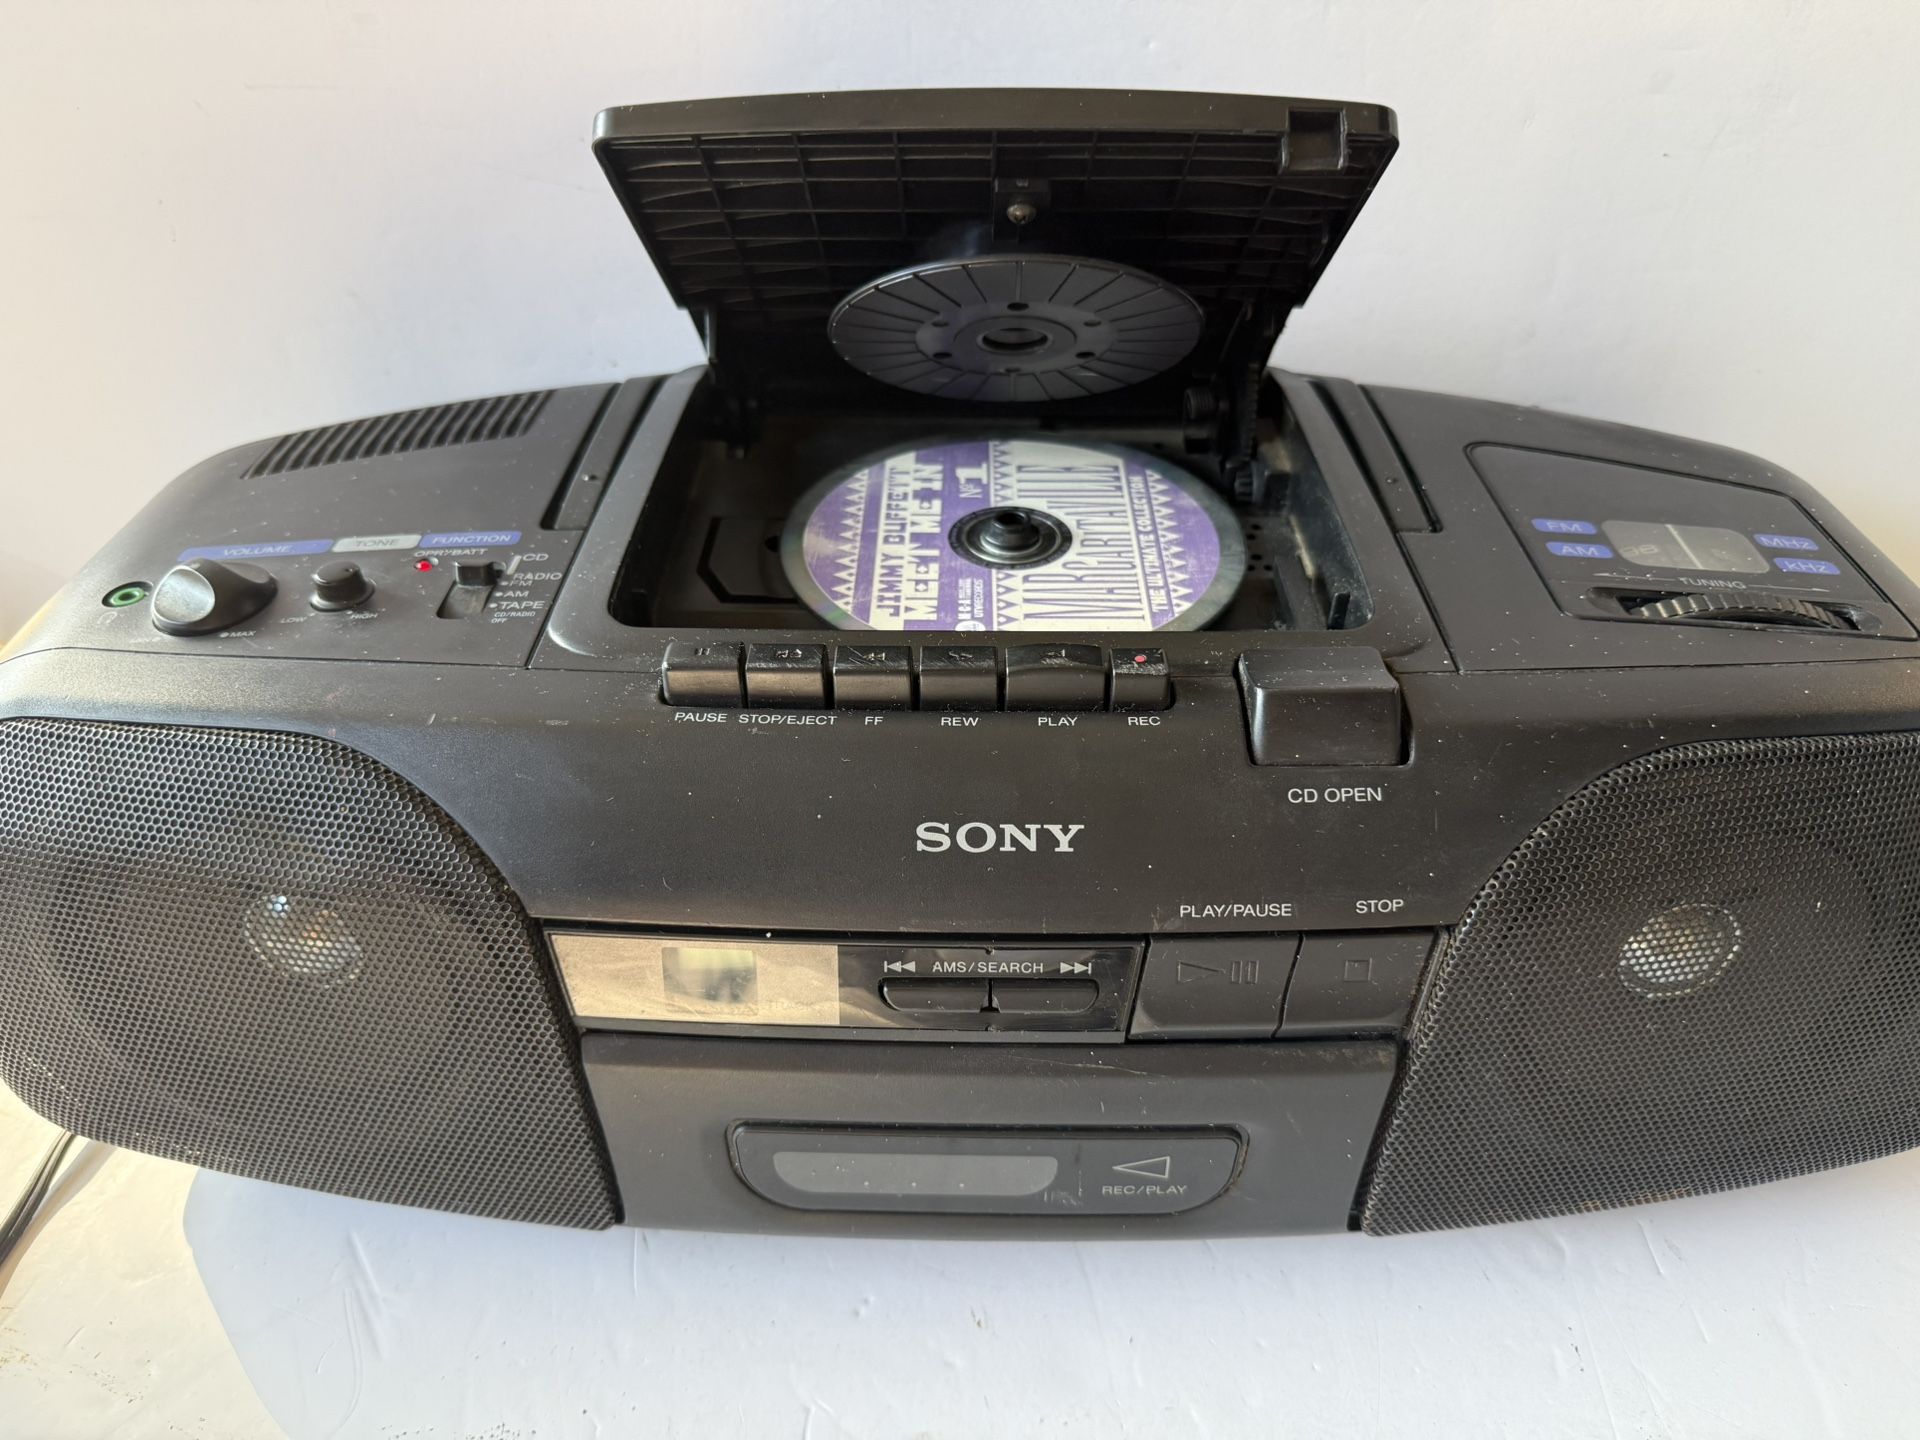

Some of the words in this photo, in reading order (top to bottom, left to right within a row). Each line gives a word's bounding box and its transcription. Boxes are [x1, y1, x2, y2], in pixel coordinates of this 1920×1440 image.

[912, 463, 944, 491] IN
[882, 467, 911, 546] BUFFETT
[1128, 475, 1153, 533] COLLECTION
[909, 499, 943, 534] ME
[1547, 522, 1582, 532] FM
[355, 538, 397, 548] TONE
[432, 535, 512, 544] FUNCTION
[1016, 464, 1146, 621] MARGARITAVILLE
[223, 544, 295, 557] VOLUME
[1562, 545, 1598, 556] AM
[522, 553, 550, 562] CD
[1138, 534, 1167, 587] ULTIMATE
[512, 572, 563, 581] RADIO
[903, 543, 941, 621] MEET
[876, 552, 905, 618] JIMMY
[1678, 577, 1746, 589] TUNING
[503, 590, 530, 598] AM
[1149, 587, 1171, 613] THE
[500, 601, 546, 609] TAPE
[350, 612, 379, 620] HIGH
[229, 630, 257, 638] MAX
[674, 711, 728, 723] PAUSE
[737, 713, 838, 726] STOP/EJECT
[864, 716, 884, 726] FF
[940, 716, 980, 727] REW
[1037, 716, 1079, 727] PLAY
[1127, 715, 1162, 726] REC
[1287, 788, 1318, 804] CD
[1323, 786, 1383, 803] OPEN
[915, 821, 1086, 854] SONY
[1179, 903, 1293, 919] PLAY/PAUSE
[1355, 898, 1405, 915] STOP
[931, 961, 1045, 975] AMS/SEARCH
[1101, 1184, 1188, 1196] REC/PLAY
